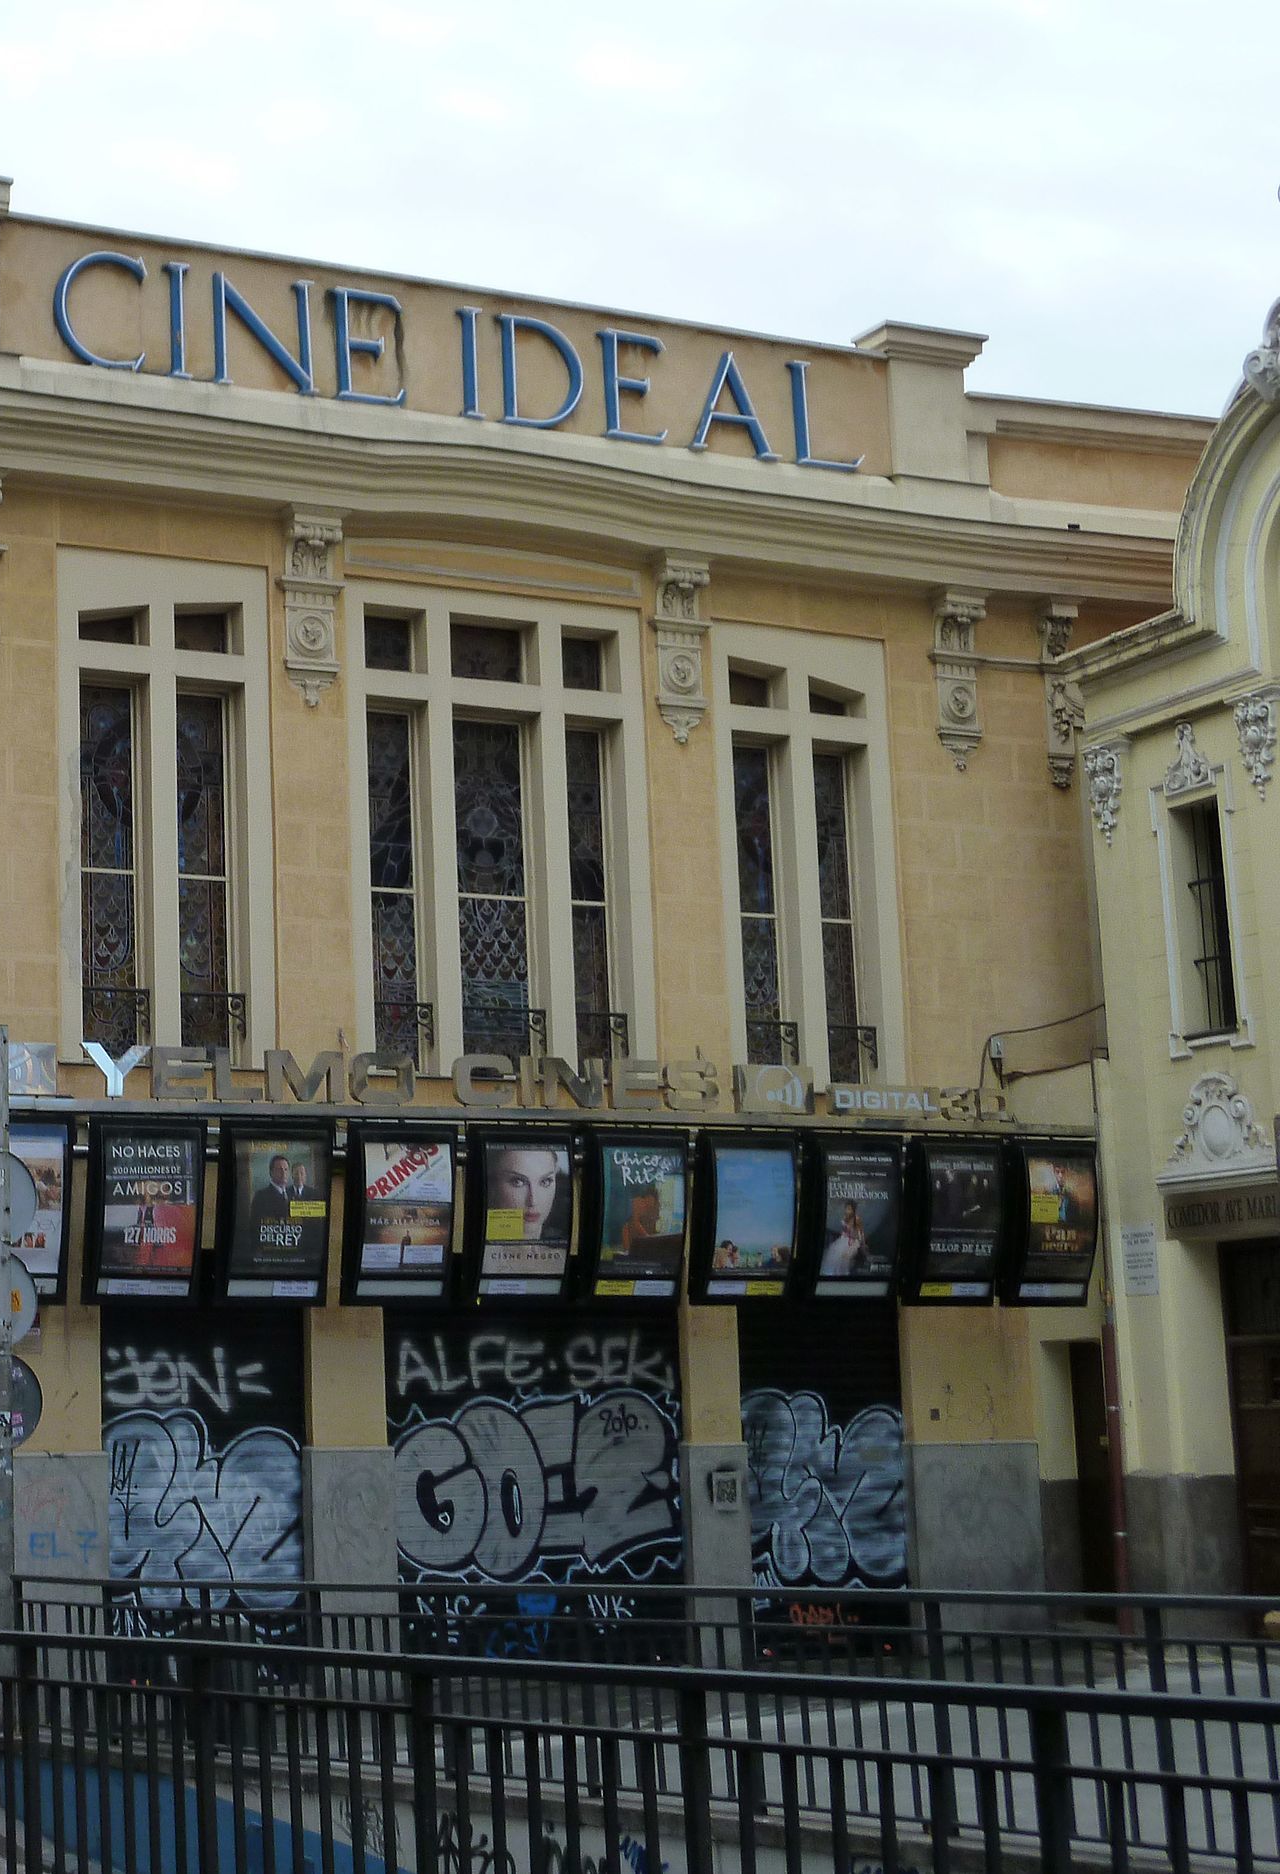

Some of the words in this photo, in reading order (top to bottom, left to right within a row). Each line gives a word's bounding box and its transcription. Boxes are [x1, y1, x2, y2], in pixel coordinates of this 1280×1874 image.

[52, 250, 407, 406] CINE
[457, 305, 866, 472] IDEAL
[79, 1040, 416, 1104] YELMO
[451, 1053, 721, 1112] CINES
[833, 1088, 939, 1113] DIGITAL
[939, 1087, 1007, 1121] 3D
[111, 1145, 135, 1159] NO
[137, 1145, 181, 1159] HACES
[613, 1149, 661, 1166] Chico
[129, 1166, 171, 1175] MILLONES
[171, 1166, 181, 1174] DE
[621, 1165, 666, 1187] Rita
[112, 1180, 183, 1196] AMIGOS
[1167, 1200, 1221, 1230] COMEDOR
[123, 1226, 141, 1244] 127
[143, 1226, 177, 1244] HORAS
[260, 1225, 303, 1234] DISCURSO
[260, 1234, 275, 1242] DEL
[276, 1234, 302, 1246] REY
[929, 1242, 960, 1253] VALOR
[962, 1243, 973, 1253] DE
[975, 1244, 993, 1254] LEY
[491, 1252, 521, 1260] CISNE
[526, 1252, 561, 1260] NEGRO
[396, 1333, 545, 1396] ALFE
[29, 1531, 71, 1560] EL
